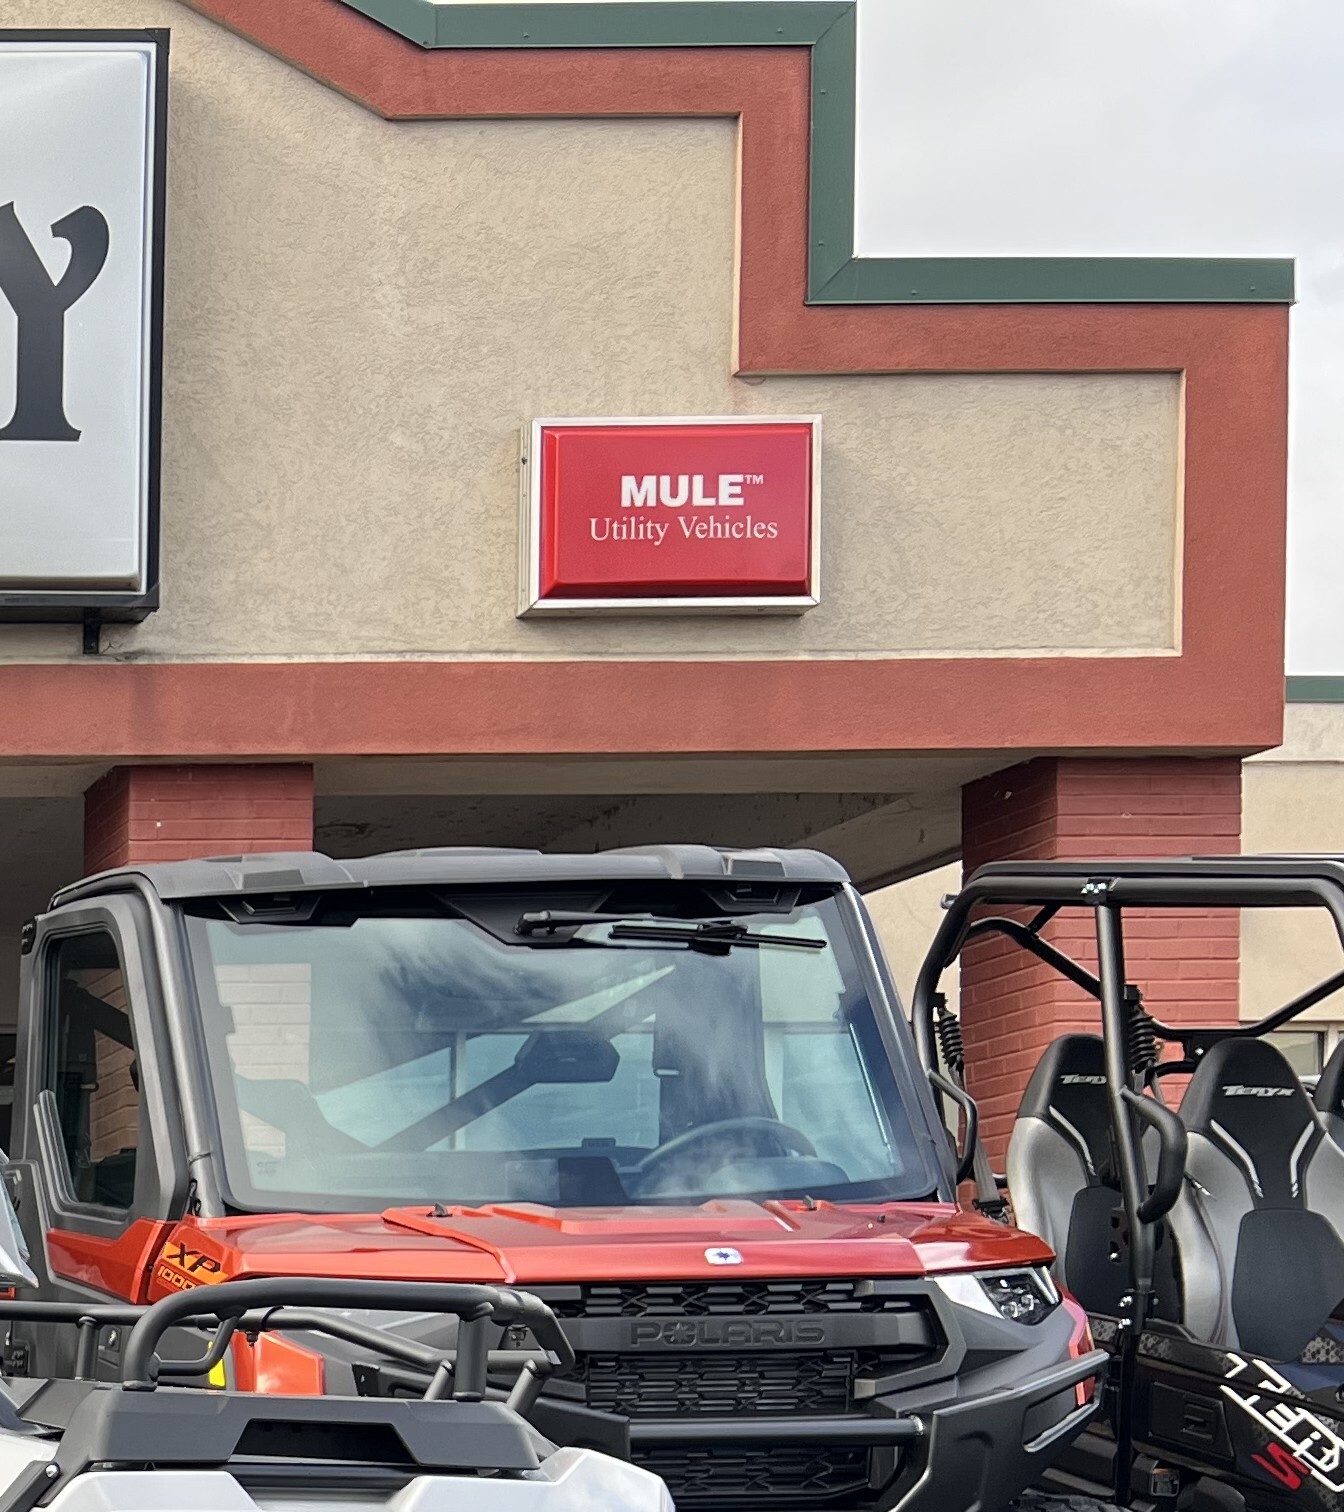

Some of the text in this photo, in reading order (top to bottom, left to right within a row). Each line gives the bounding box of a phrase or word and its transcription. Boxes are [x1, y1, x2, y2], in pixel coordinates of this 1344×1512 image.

[590, 516, 779, 546] Utility Vehicles
[166, 1242, 222, 1273] XP
[629, 1318, 826, 1348] POLARIS
